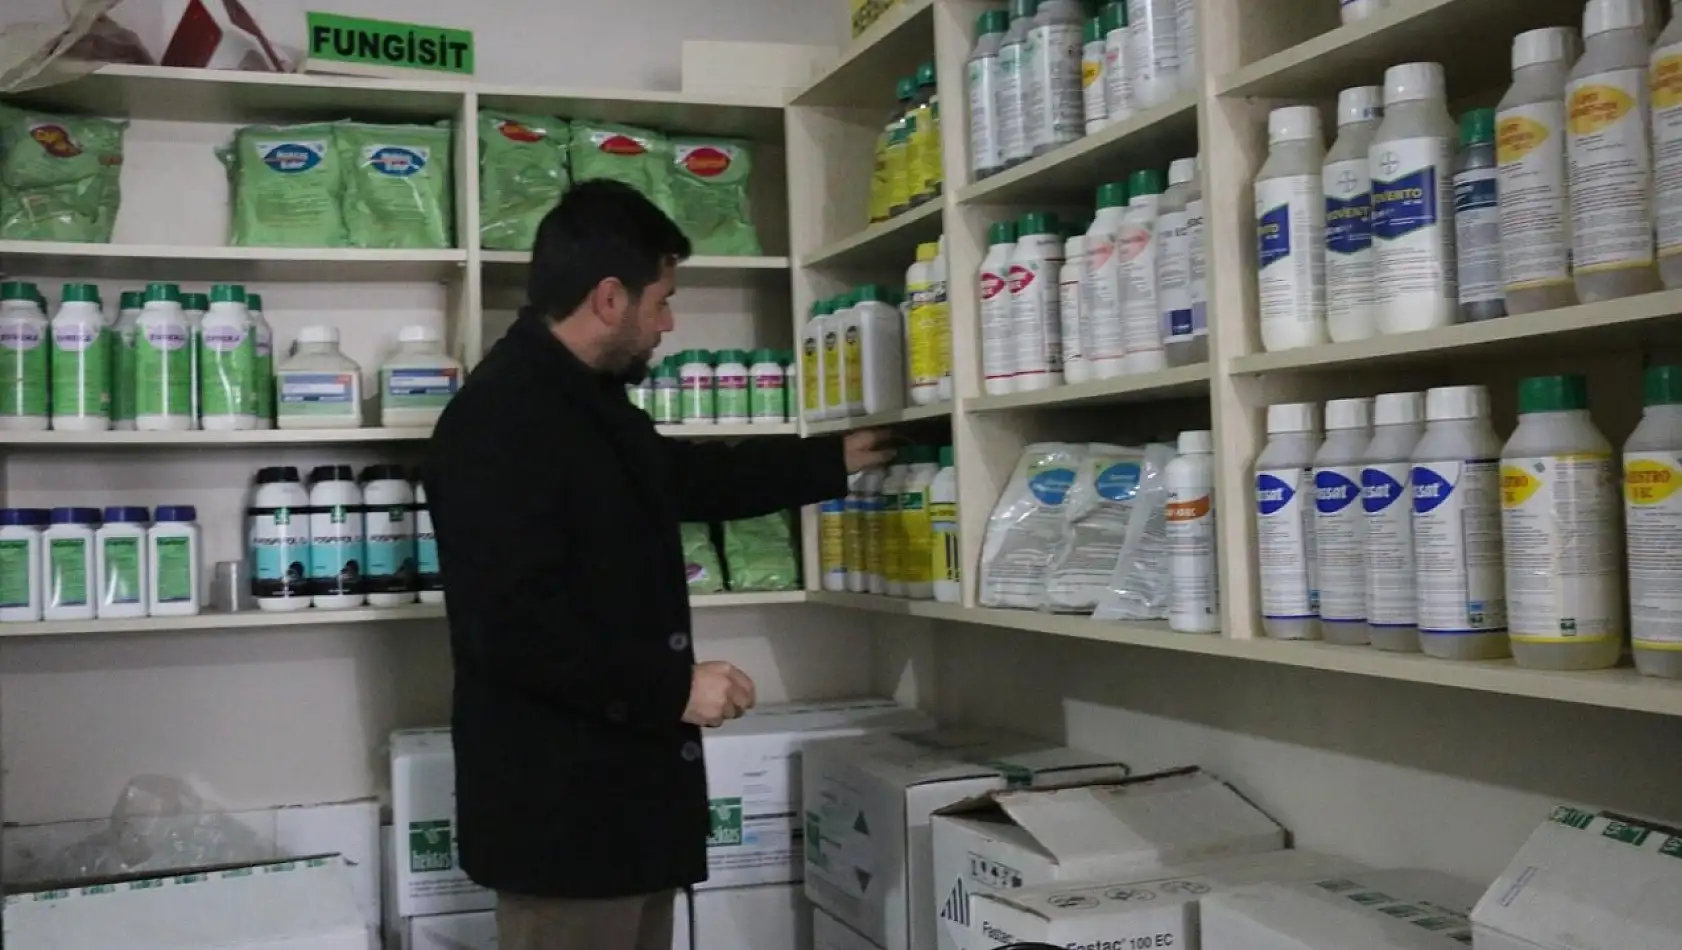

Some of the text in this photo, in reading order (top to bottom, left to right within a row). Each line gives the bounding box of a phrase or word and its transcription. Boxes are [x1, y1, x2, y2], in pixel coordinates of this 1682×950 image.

[313, 25, 468, 68] FUNGİSİT
[1129, 936, 1152, 949] 100
[1155, 933, 1174, 947] EC
